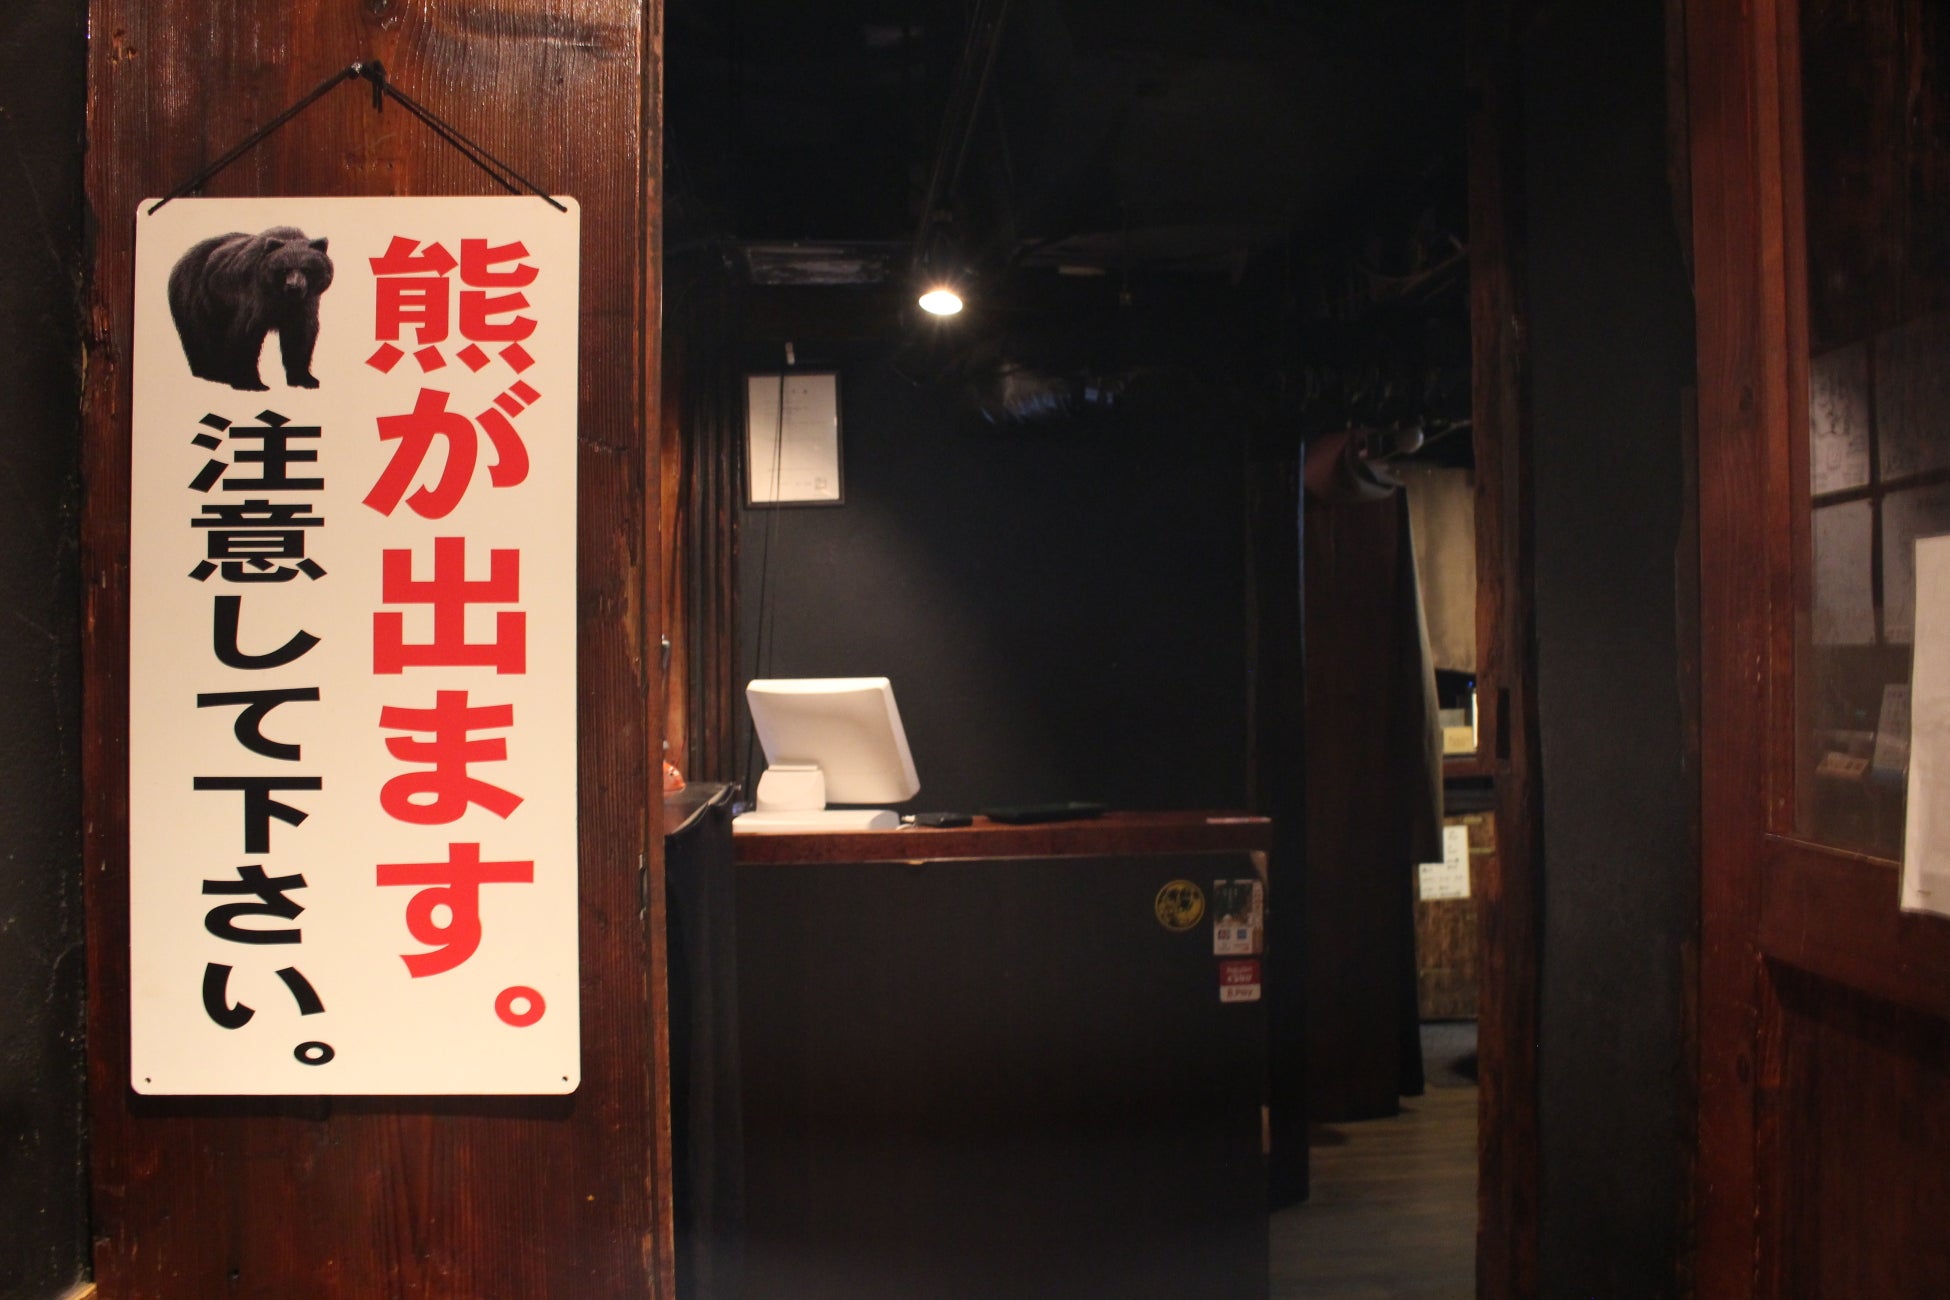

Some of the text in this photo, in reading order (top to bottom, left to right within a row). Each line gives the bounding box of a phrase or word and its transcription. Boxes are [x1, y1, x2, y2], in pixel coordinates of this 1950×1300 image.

[188, 409, 335, 1066] 注意して下さい。
[362, 235, 546, 1028] 熊が出ます。
